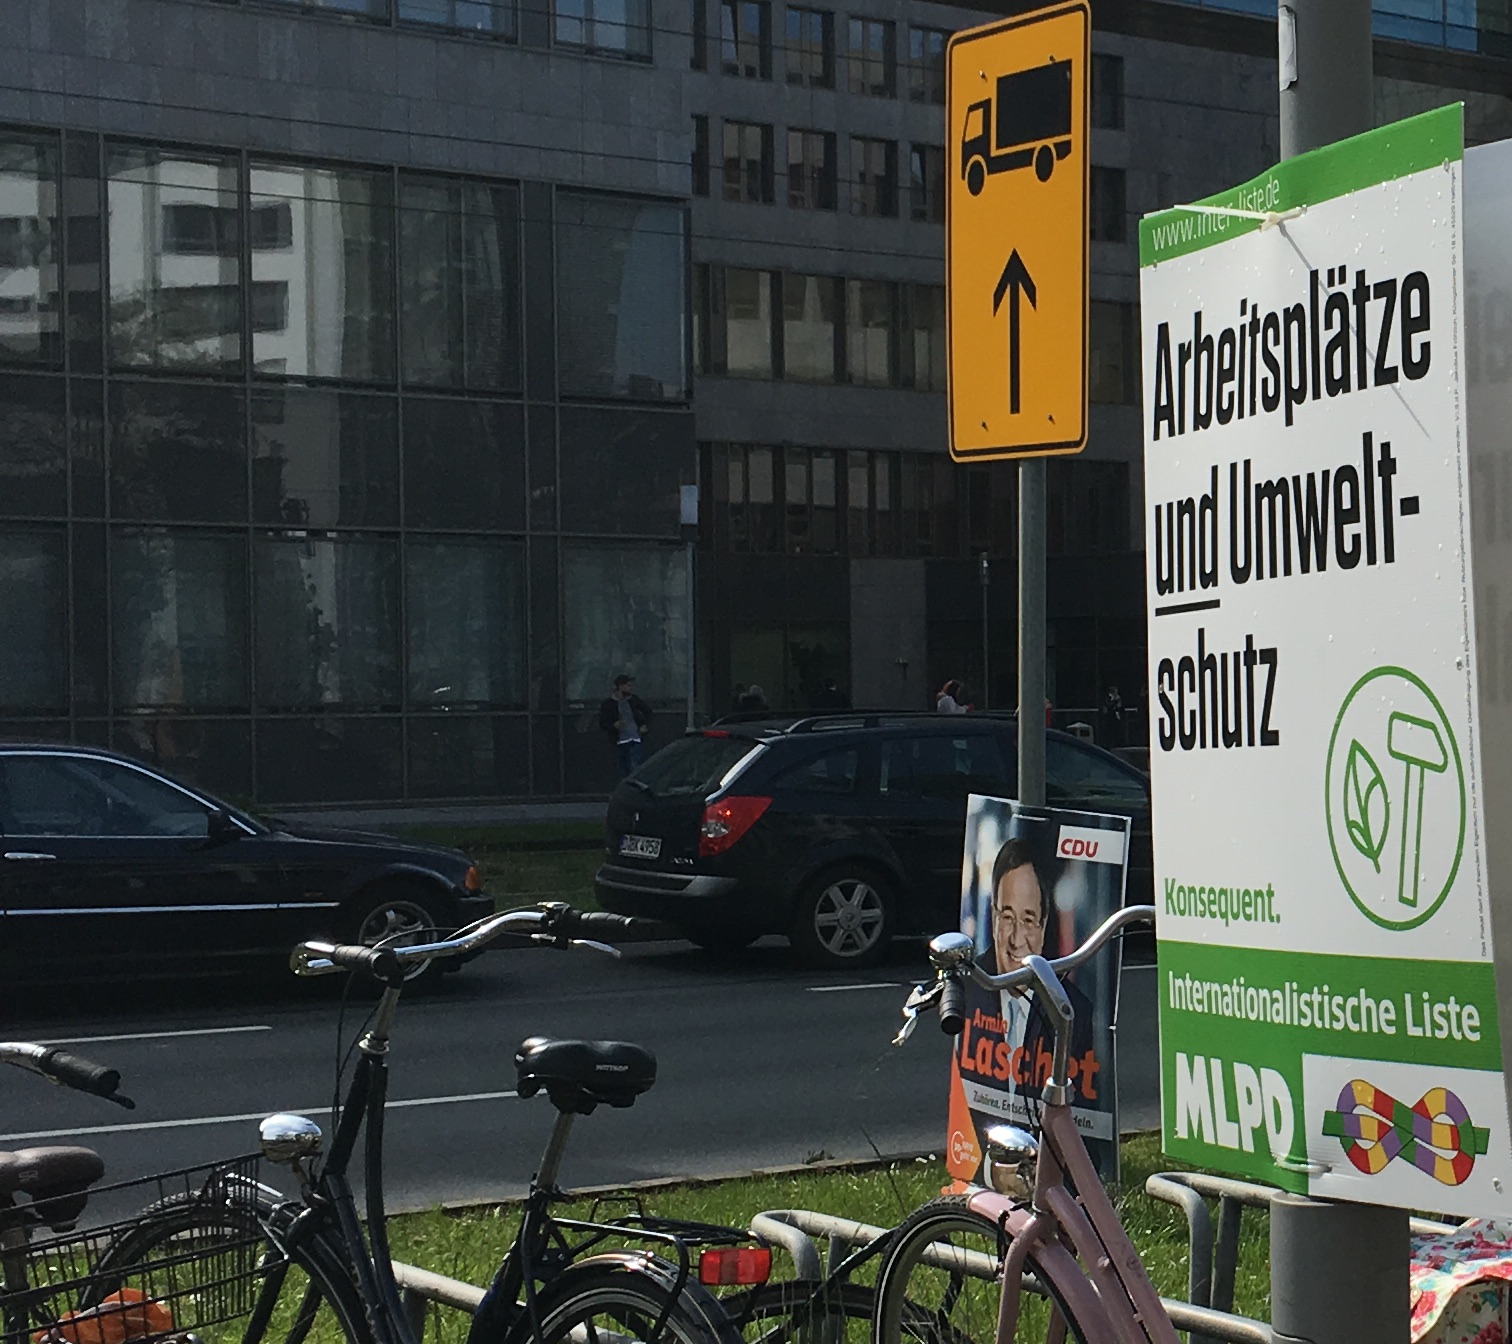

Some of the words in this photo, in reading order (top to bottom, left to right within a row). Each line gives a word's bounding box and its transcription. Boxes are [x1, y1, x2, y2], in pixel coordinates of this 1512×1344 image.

[1152, 175, 1280, 251] www.interliste.de
[1153, 264, 1431, 441] Arbeitsplätze
[1155, 464, 1219, 597] und
[1229, 431, 1419, 586] Umwelt-
[1157, 626, 1280, 753] schutz
[1060, 838, 1099, 858] CDU
[1164, 876, 1281, 928] Konsequent.
[1168, 970, 1396, 1035] Internationalistische
[1404, 992, 1481, 1042] Liste
[1174, 1051, 1295, 1159] MLPD
